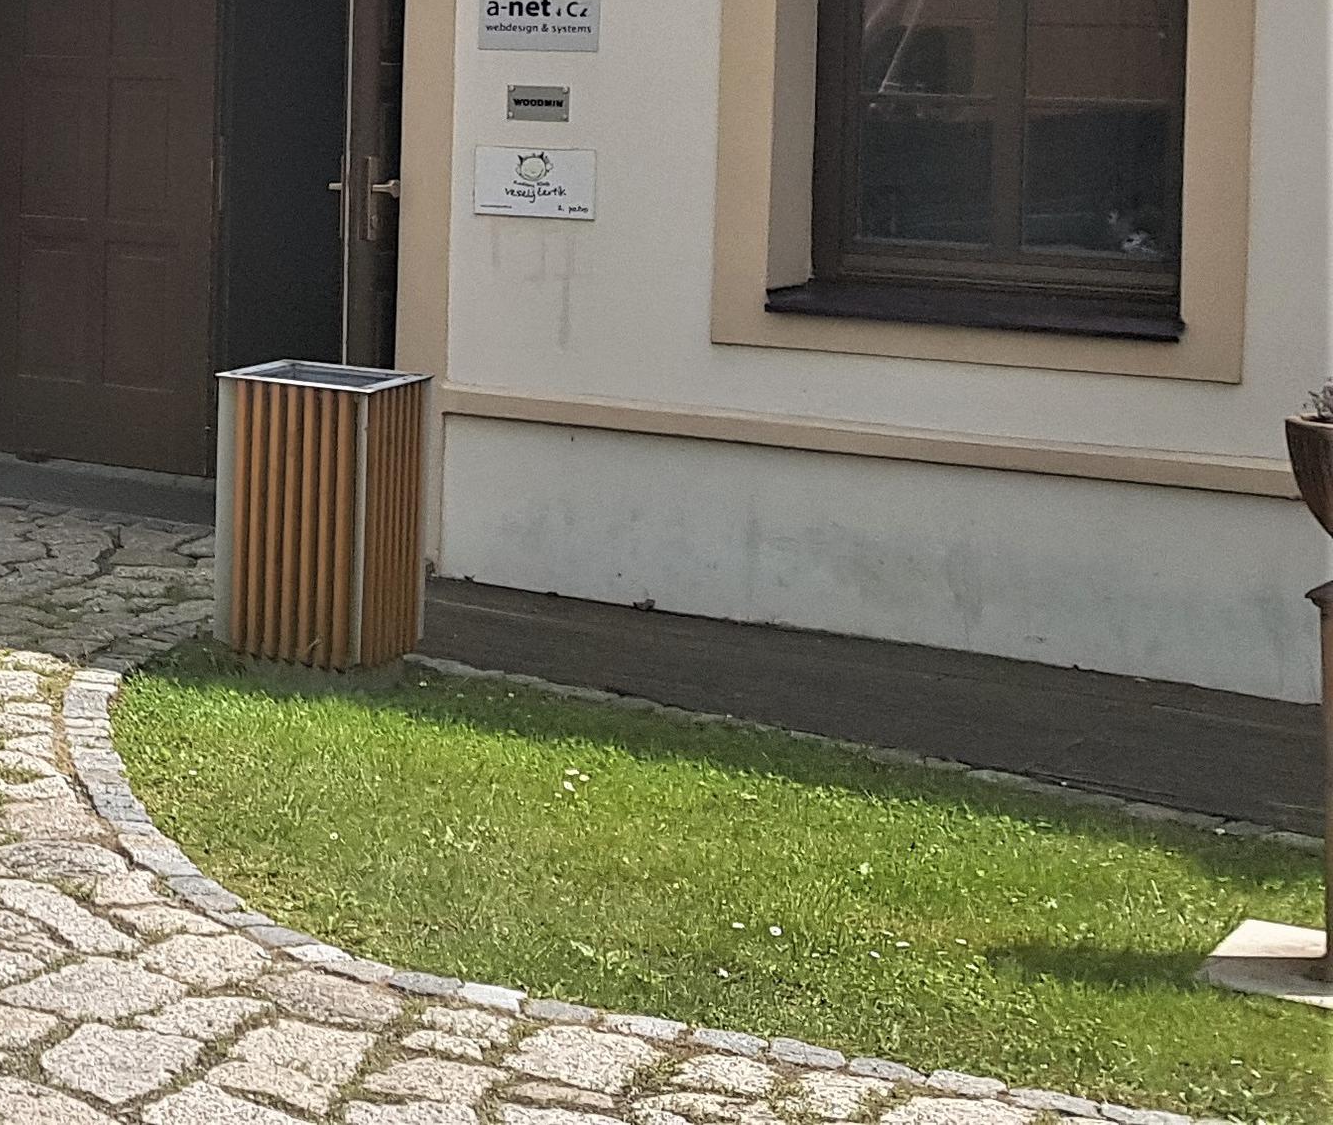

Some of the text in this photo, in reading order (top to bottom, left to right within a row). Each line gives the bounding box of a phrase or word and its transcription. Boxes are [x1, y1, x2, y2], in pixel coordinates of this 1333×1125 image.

[485, 23, 592, 34] webdesign & systems
